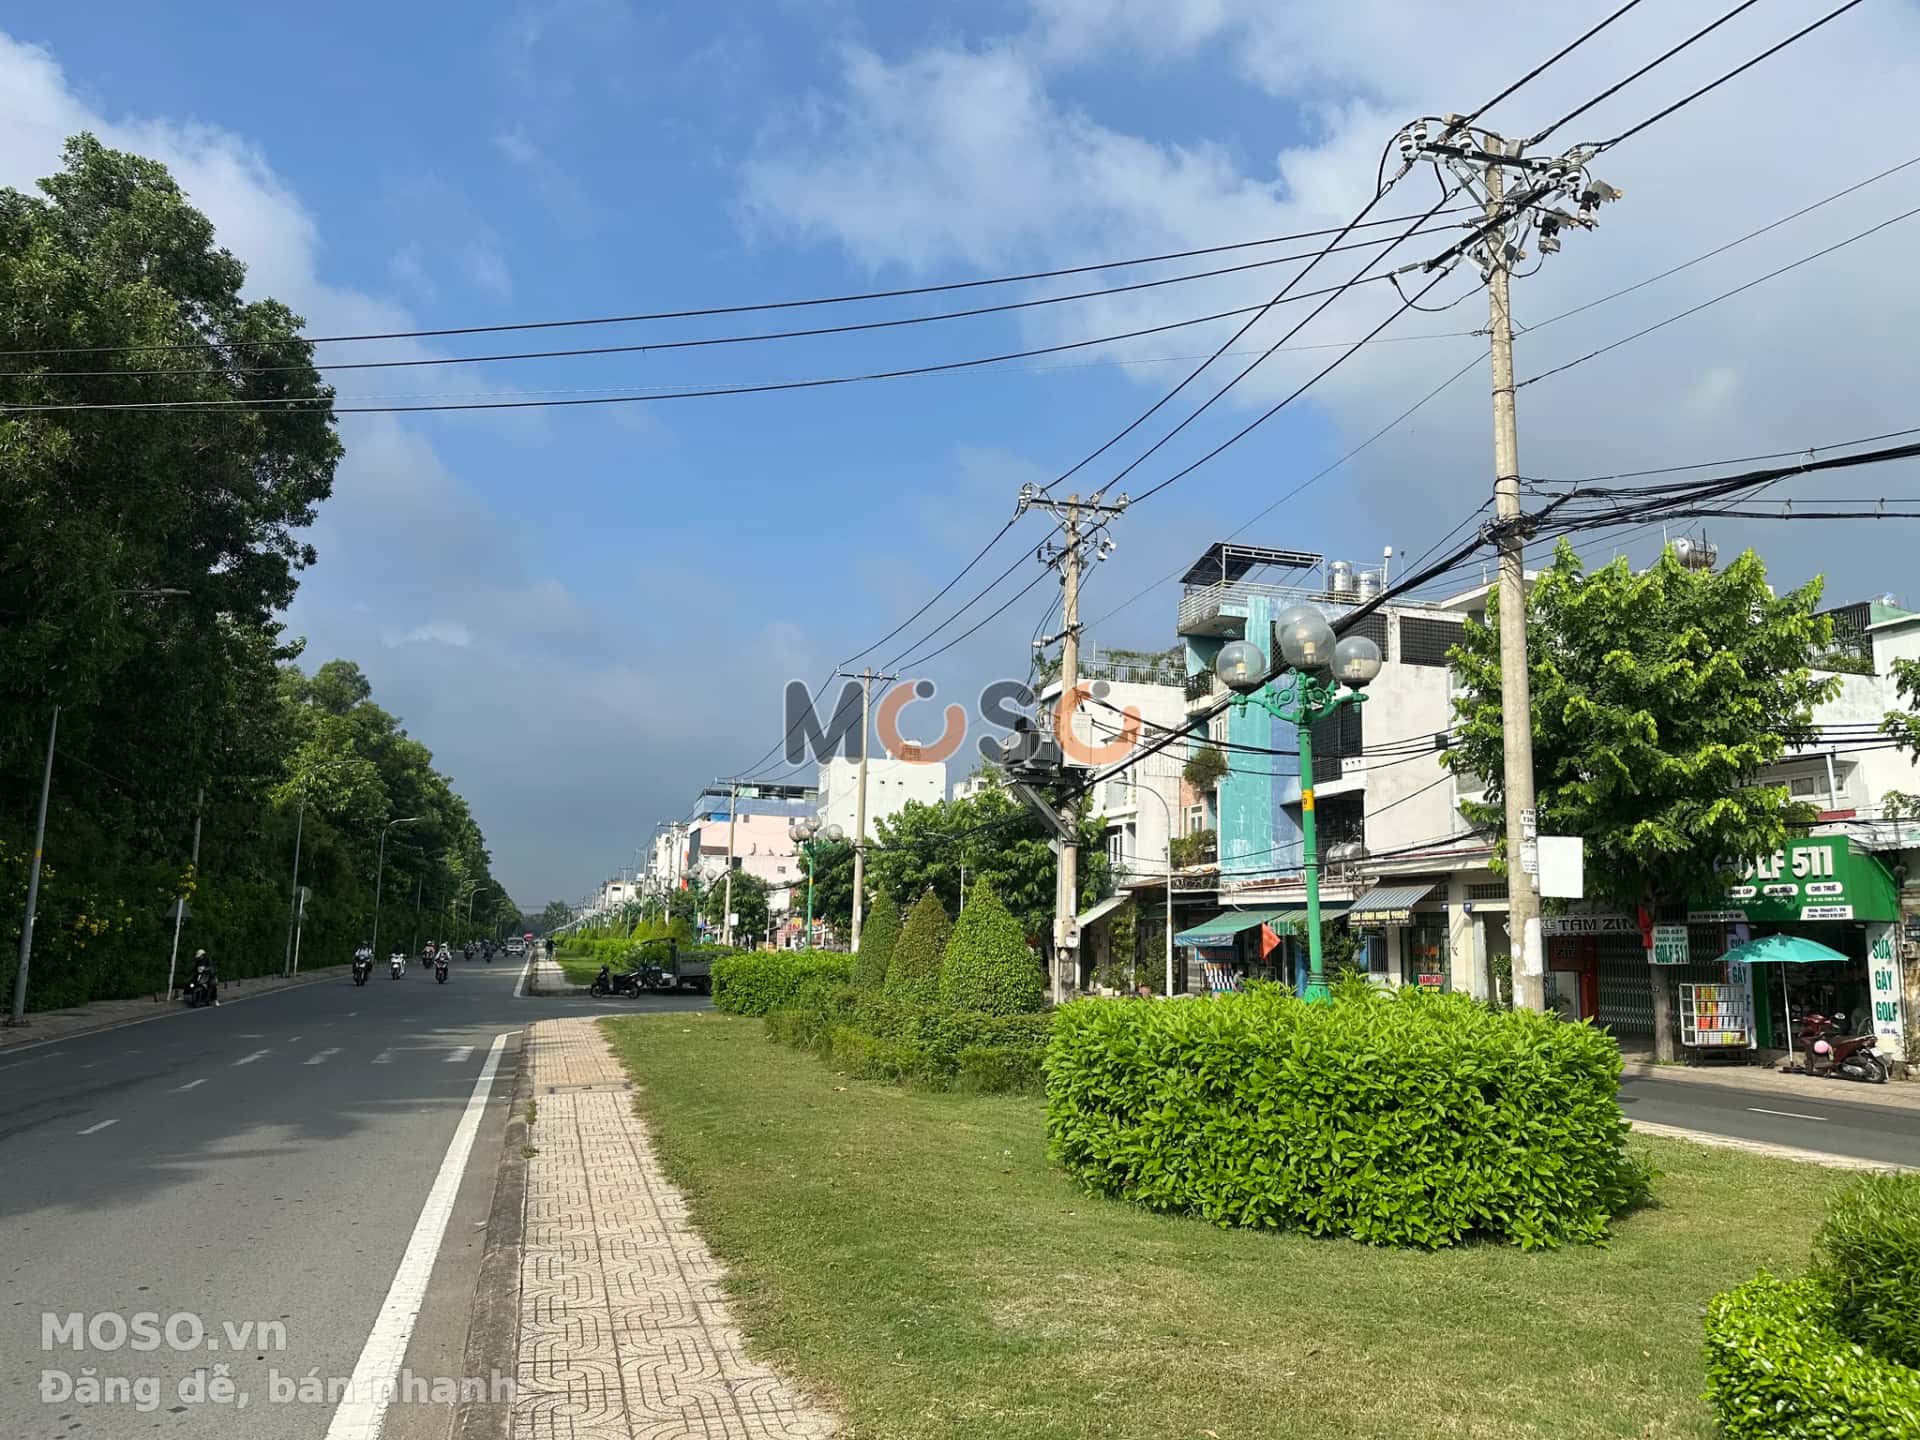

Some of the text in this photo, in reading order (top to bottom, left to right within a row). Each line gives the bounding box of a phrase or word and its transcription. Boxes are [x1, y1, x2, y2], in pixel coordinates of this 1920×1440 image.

[1792, 845, 1833, 878] 511
[1655, 943, 1689, 963] GOLF 511
[1874, 967, 1892, 995] GẬY
[1875, 1001, 1898, 1021] GOLF
